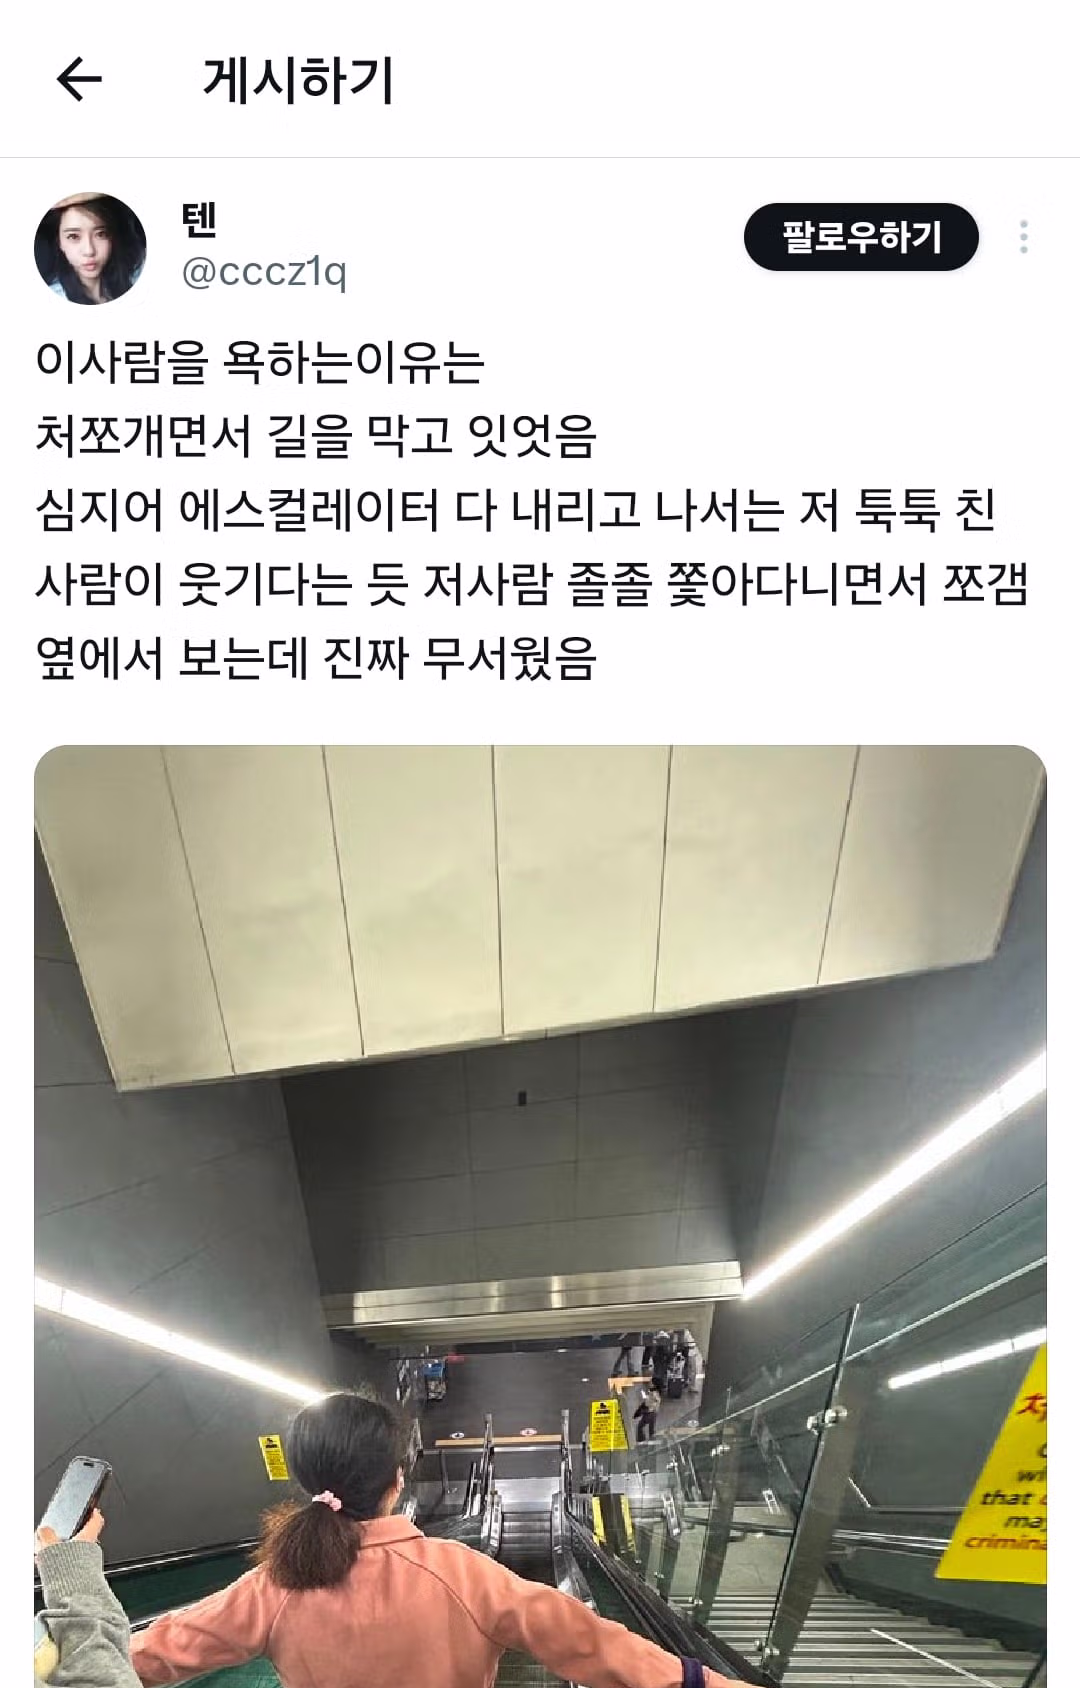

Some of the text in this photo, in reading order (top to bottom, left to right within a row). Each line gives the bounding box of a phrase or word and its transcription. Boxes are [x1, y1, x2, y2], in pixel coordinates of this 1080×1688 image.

[203, 56, 391, 105] 게시하기
[183, 202, 216, 238] 텐
[783, 220, 941, 254] 팔로우하기
[183, 255, 345, 293] @cccz1q
[37, 340, 484, 385] 이사람을 욕하는이유는
[36, 414, 596, 459] 처쪼개면서 길을 막고 잇엇음
[36, 488, 994, 533] 심지어 에스컬레이터 다 내리고 나서는 저 툭툭 친
[35, 562, 1026, 607] 사람이 웃기다는 듯 저사람 졸졸 쫓아다니면서 쪼갬
[37, 636, 596, 681] 옆에서 보는데 진짜 무서웠음
[981, 1489, 1033, 1506] that
